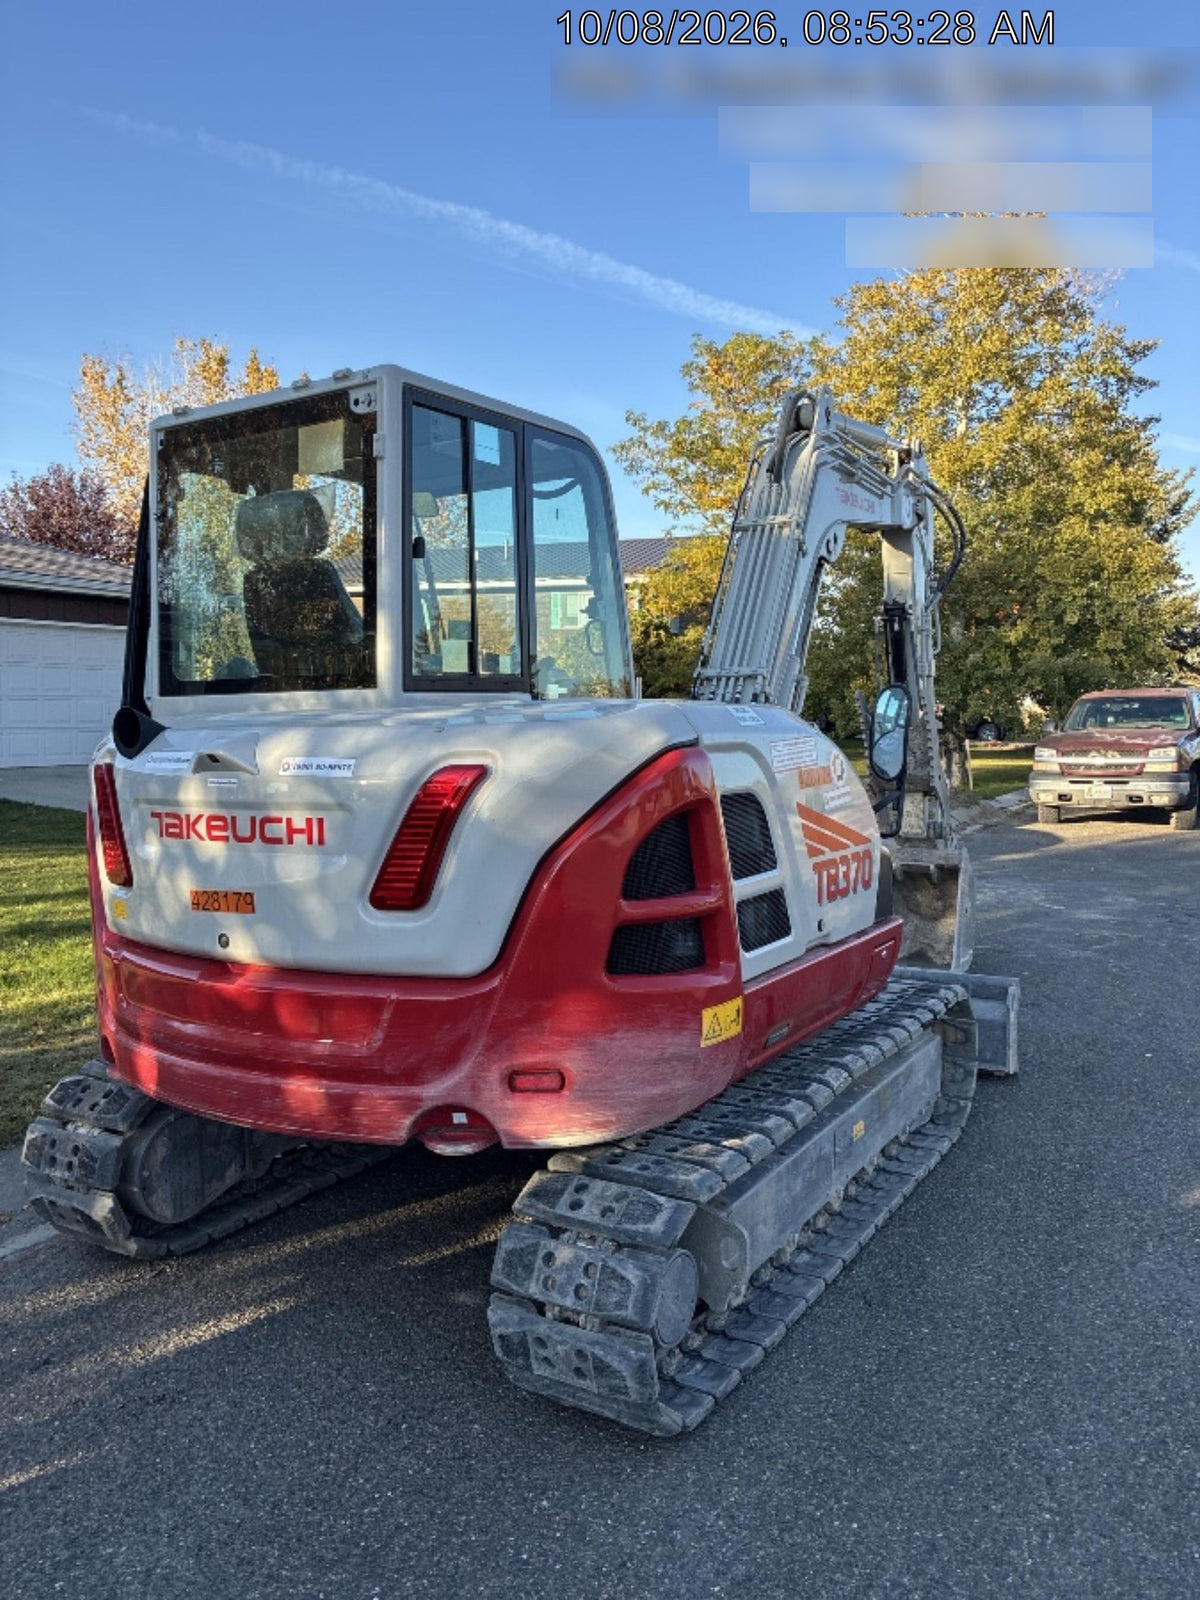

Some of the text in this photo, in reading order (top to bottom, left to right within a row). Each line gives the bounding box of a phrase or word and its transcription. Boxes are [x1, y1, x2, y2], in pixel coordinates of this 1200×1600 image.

[151, 811, 325, 846] TAKEUCHI
[812, 848, 873, 906] TB370
[191, 890, 255, 912] 428179
